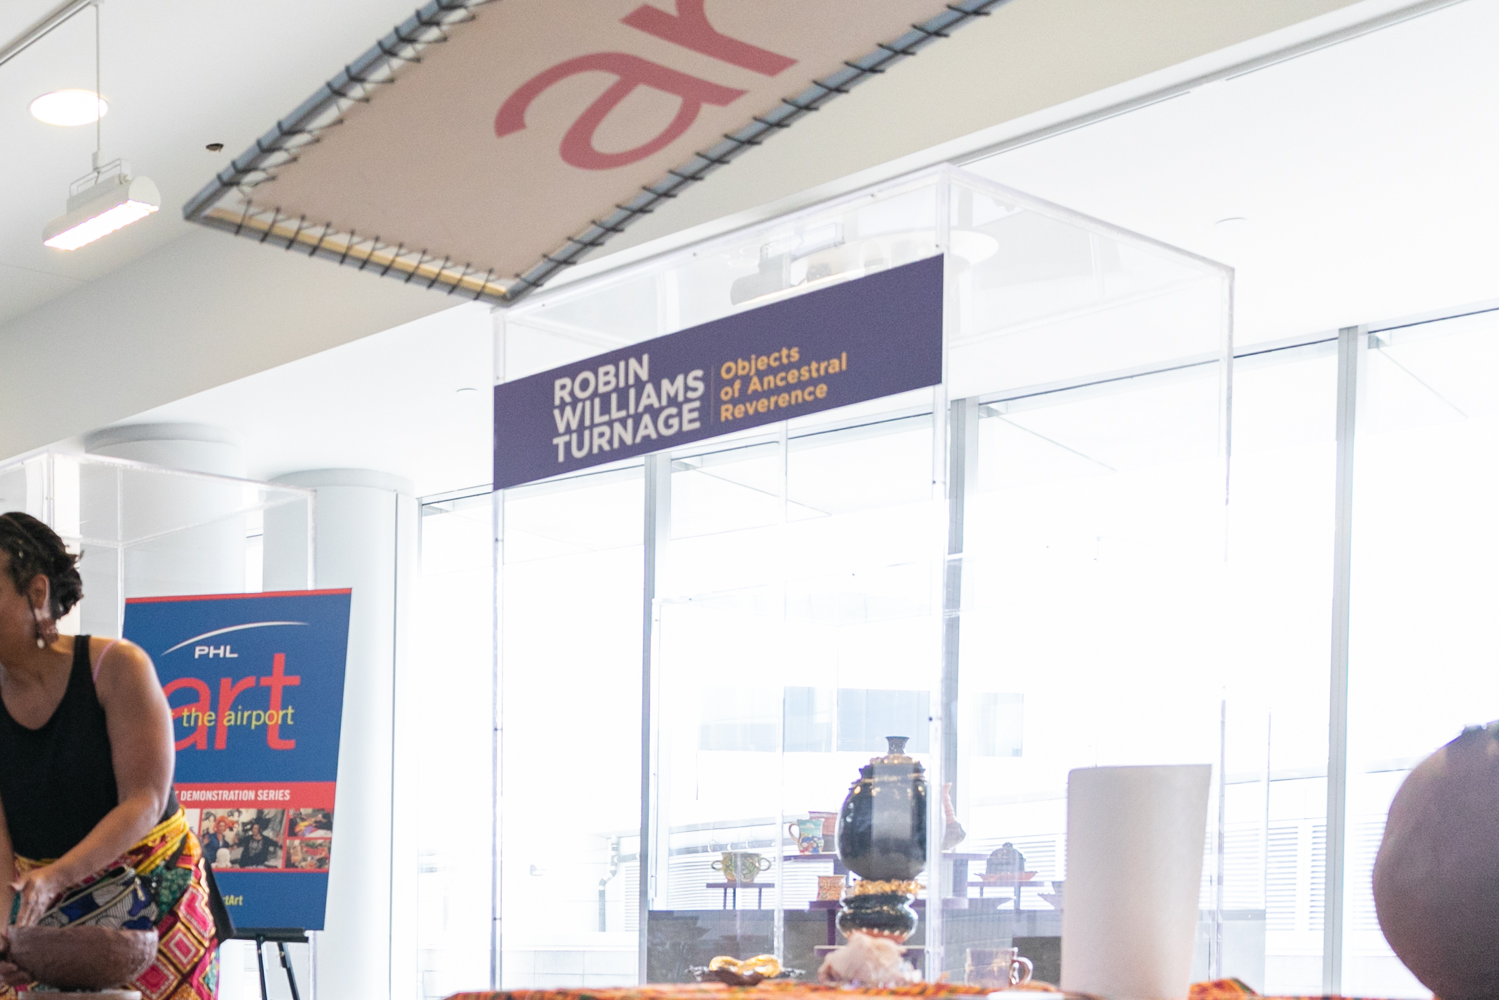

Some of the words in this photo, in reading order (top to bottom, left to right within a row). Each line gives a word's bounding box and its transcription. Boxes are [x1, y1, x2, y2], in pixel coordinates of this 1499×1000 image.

[553, 353, 650, 406] ROBIN
[720, 347, 801, 380] Objects
[720, 379, 743, 402] of
[746, 351, 848, 395] Ancestral
[552, 368, 705, 434] WILLIAMS
[720, 383, 828, 422] Reverence
[552, 400, 702, 463] TURNAGE
[194, 645, 239, 659] PHL
[162, 652, 301, 751] art
[181, 707, 216, 727] the
[223, 705, 295, 730] airport
[180, 790, 255, 801] DEMONSTRATION
[257, 789, 291, 800] SERIES
